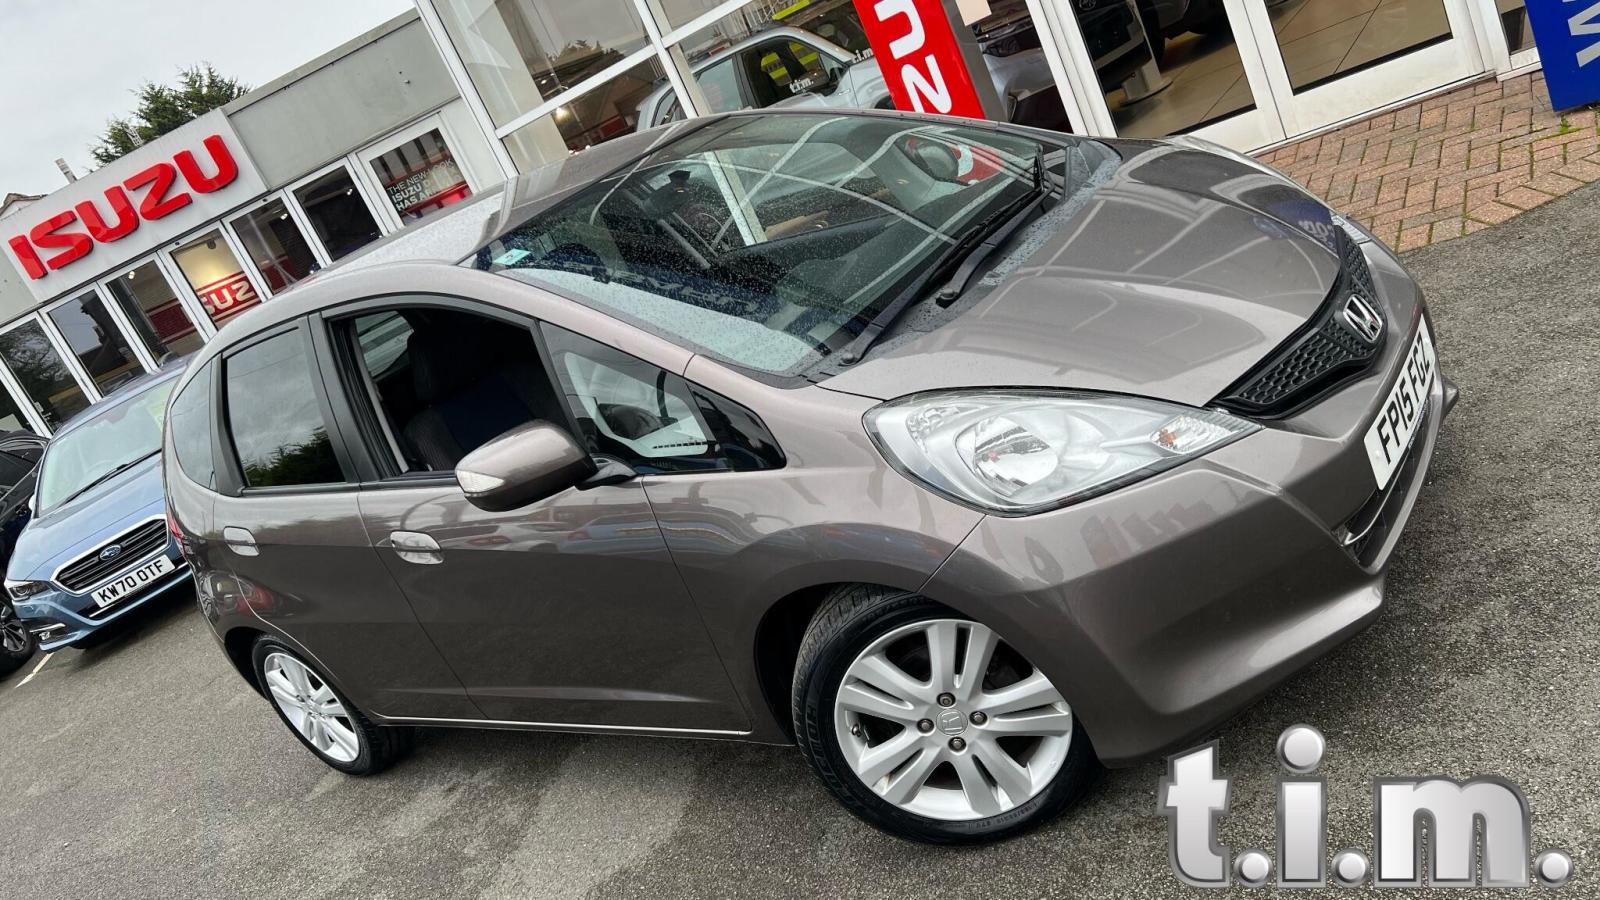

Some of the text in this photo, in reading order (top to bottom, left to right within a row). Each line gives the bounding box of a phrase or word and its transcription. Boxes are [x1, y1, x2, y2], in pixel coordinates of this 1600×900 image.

[387, 181, 406, 195] THE
[391, 183, 422, 203] ISUZU
[395, 195, 417, 210] HAS
[8, 134, 239, 281] ISUZU
[1377, 376, 1415, 465] FP15
[97, 559, 165, 602] KW70 OTF
